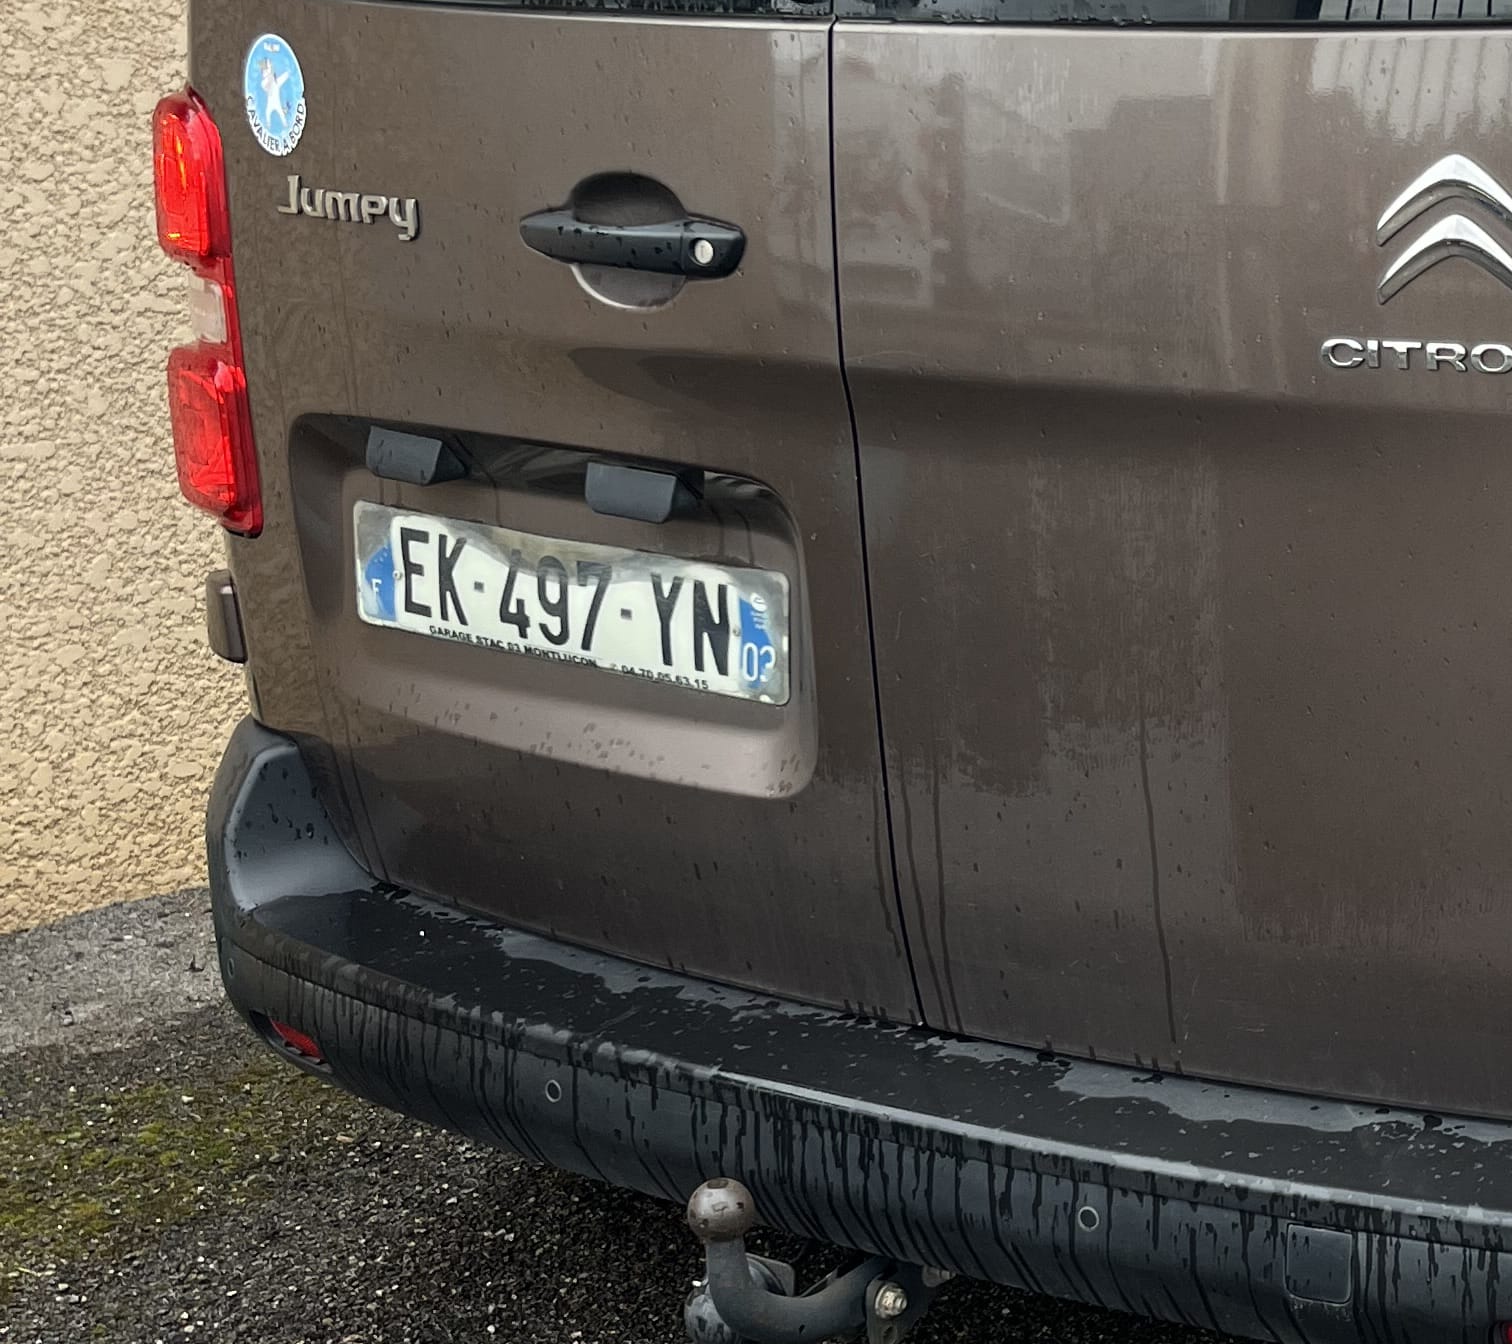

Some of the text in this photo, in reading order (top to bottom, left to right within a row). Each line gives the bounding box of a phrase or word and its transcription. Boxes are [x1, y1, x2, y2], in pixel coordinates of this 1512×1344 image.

[247, 95, 281, 152] CAVALIER
[288, 103, 305, 145] BORD
[278, 175, 418, 241] Jumpy
[400, 527, 730, 677] EK-497-YN
[429, 625, 474, 645] GARAGE
[475, 635, 505, 650] STAC
